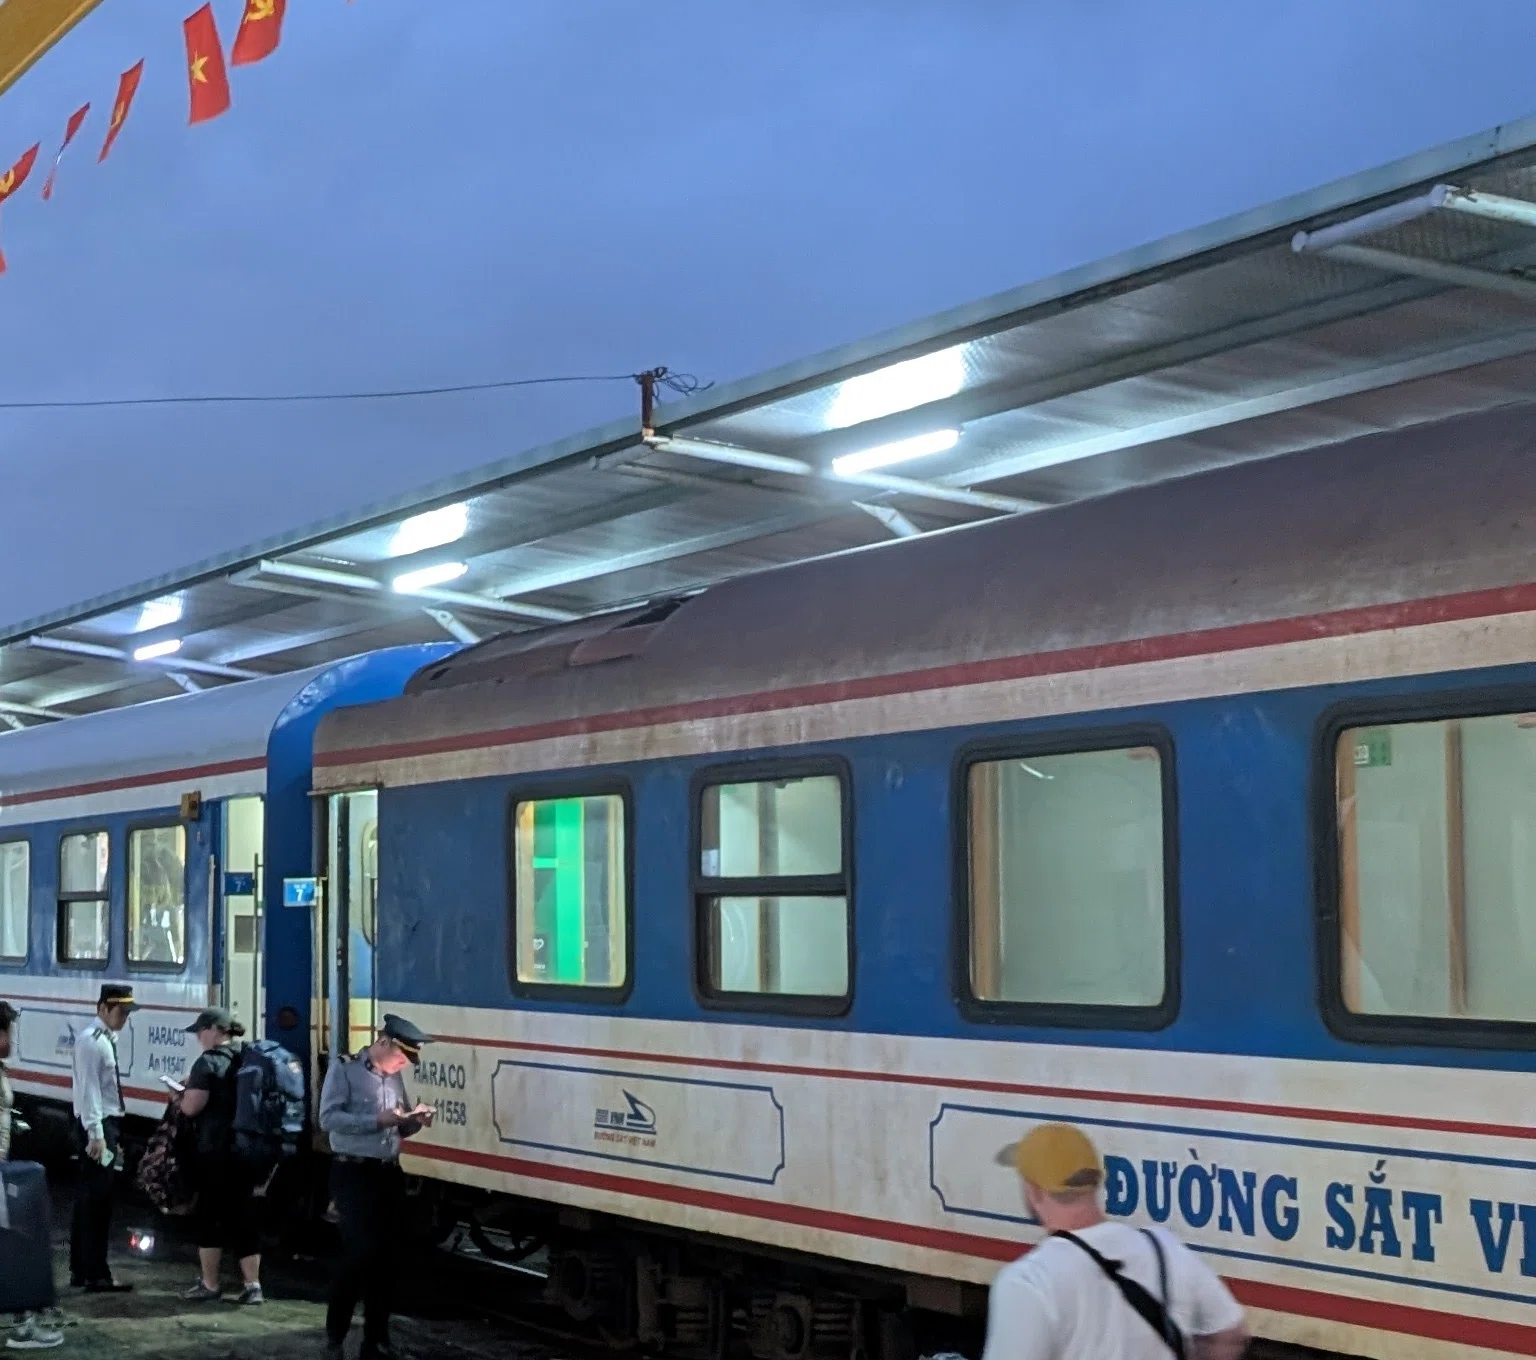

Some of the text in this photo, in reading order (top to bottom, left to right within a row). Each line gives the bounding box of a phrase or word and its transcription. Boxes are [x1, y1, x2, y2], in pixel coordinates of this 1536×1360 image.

[295, 888, 304, 902] 7
[1103, 1148, 1300, 1242] ĐƯỜNG
[1325, 1159, 1443, 1262] SẮT
